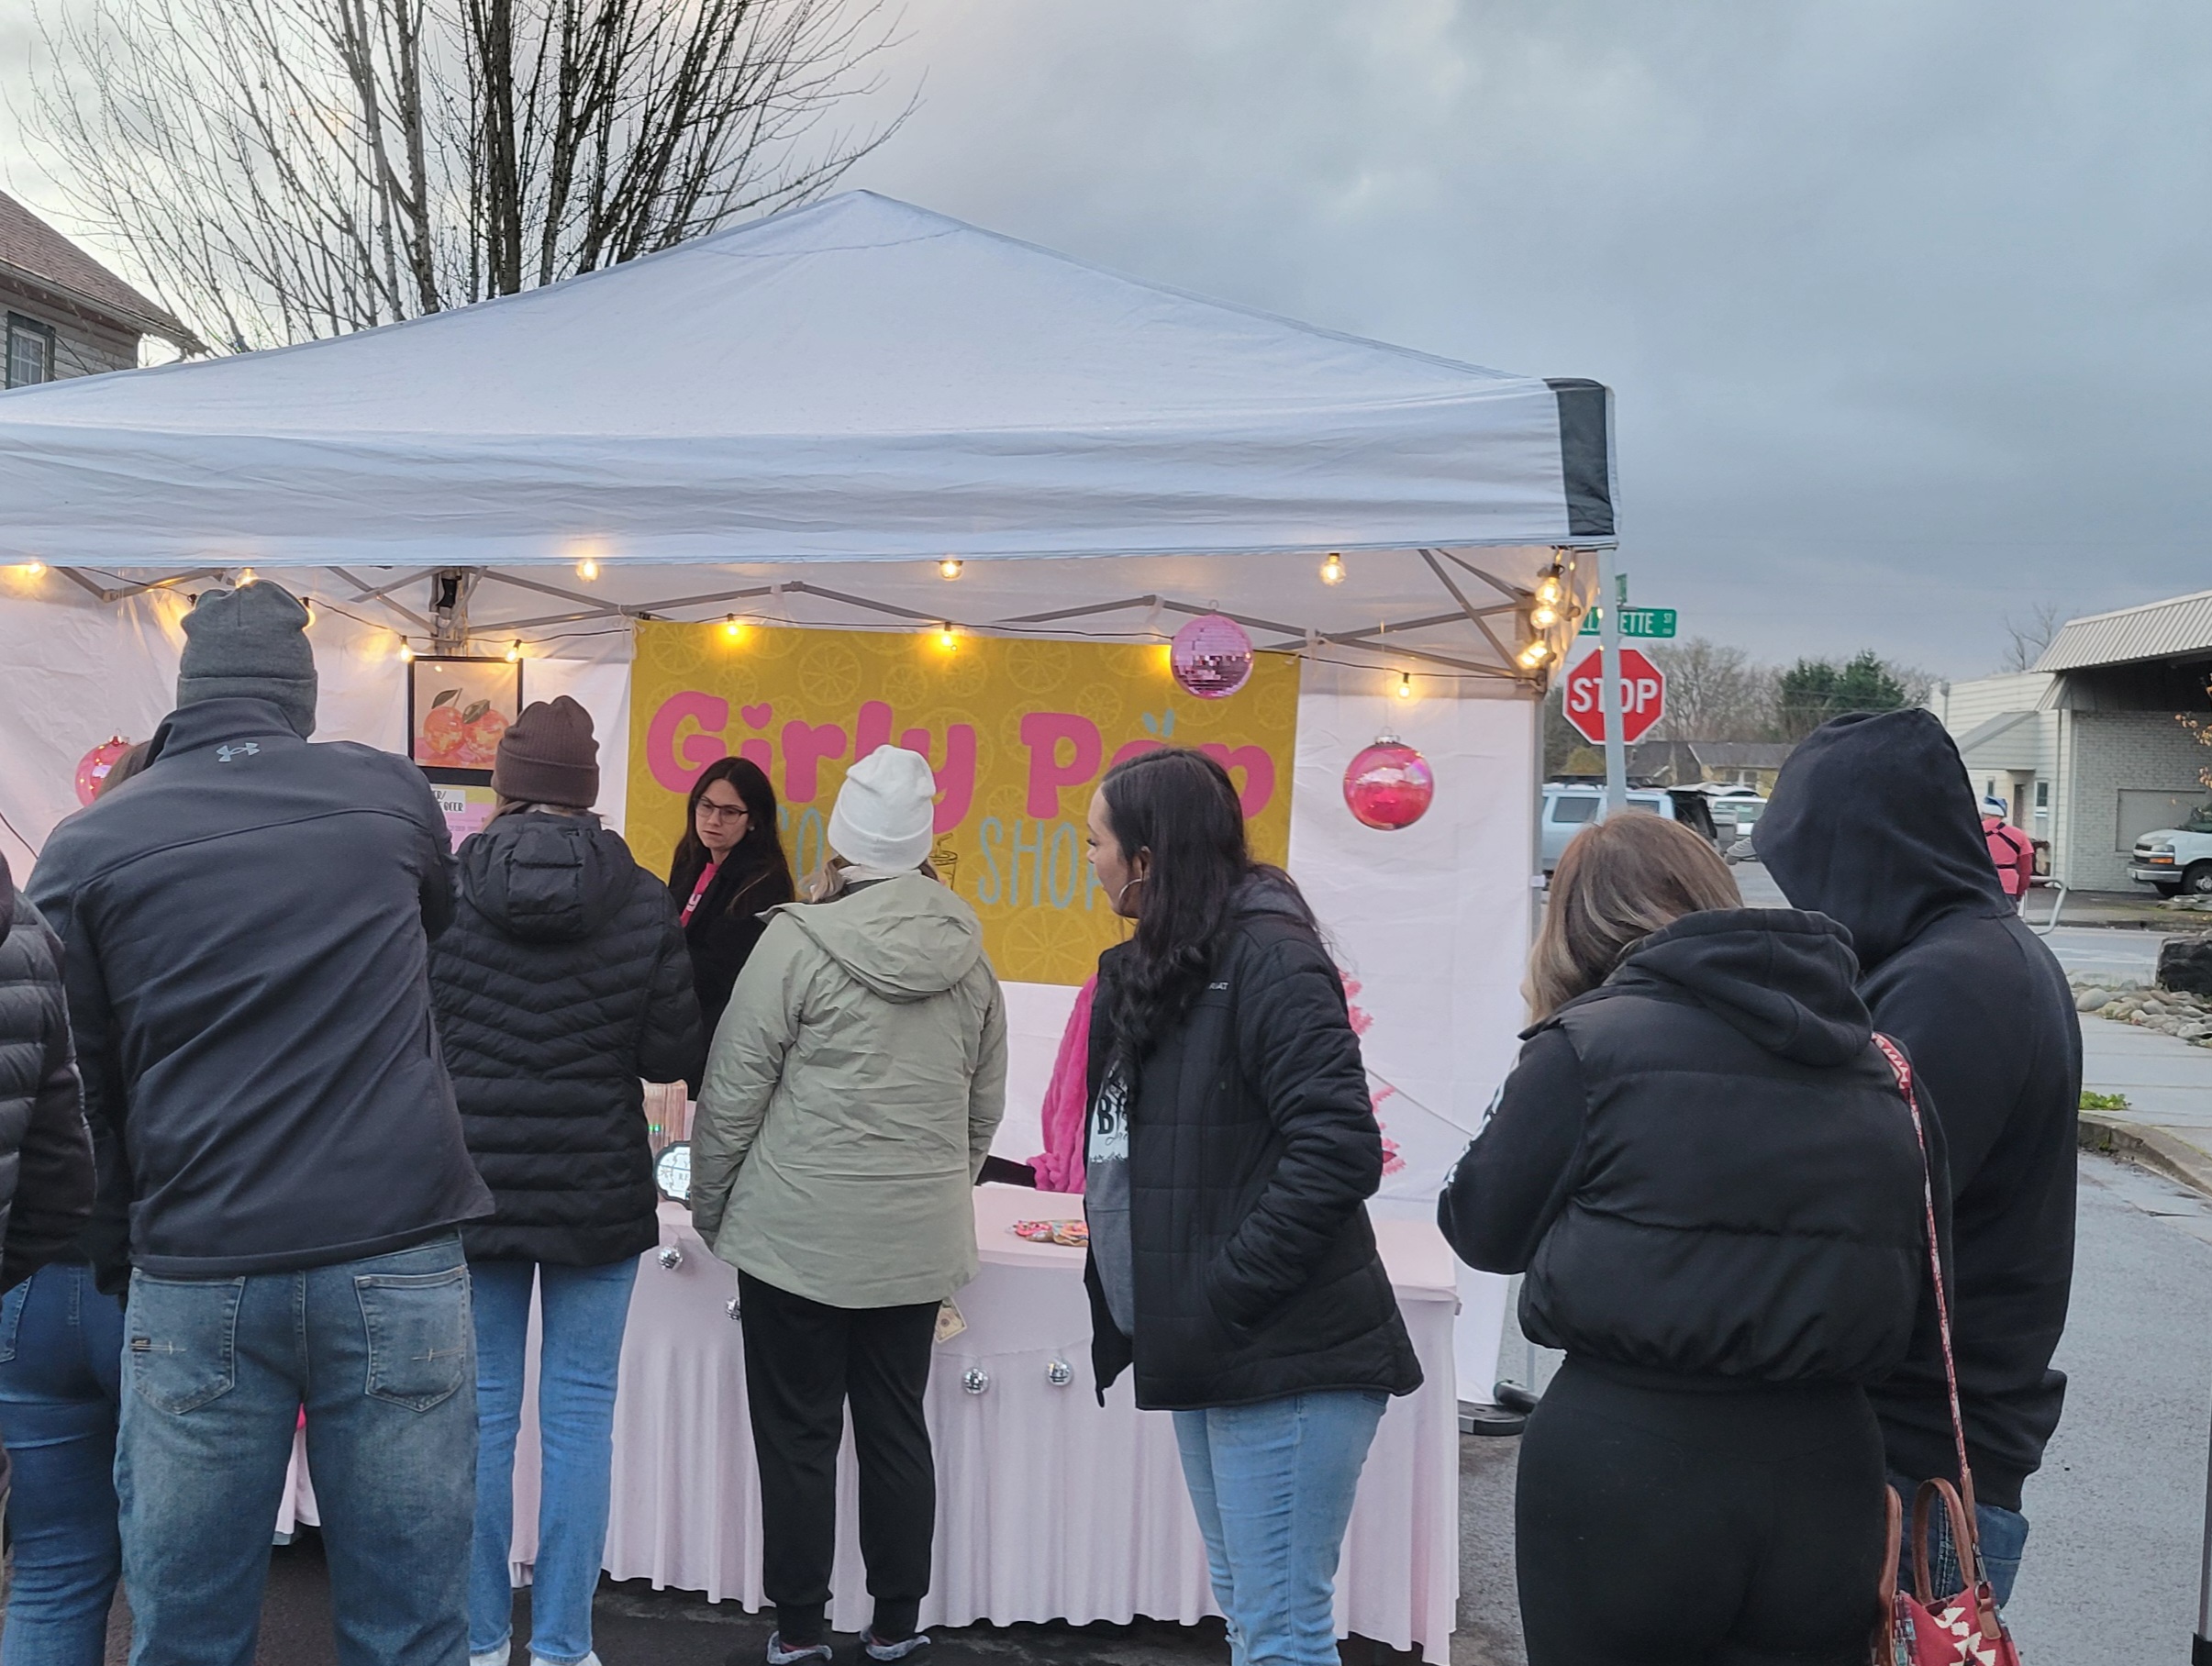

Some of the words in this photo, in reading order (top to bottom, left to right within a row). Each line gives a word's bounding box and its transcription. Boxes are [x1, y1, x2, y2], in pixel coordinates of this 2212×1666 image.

[1571, 676, 1658, 714] STOP
[647, 691, 975, 835] Girly
[1020, 711, 1274, 820] Pp
